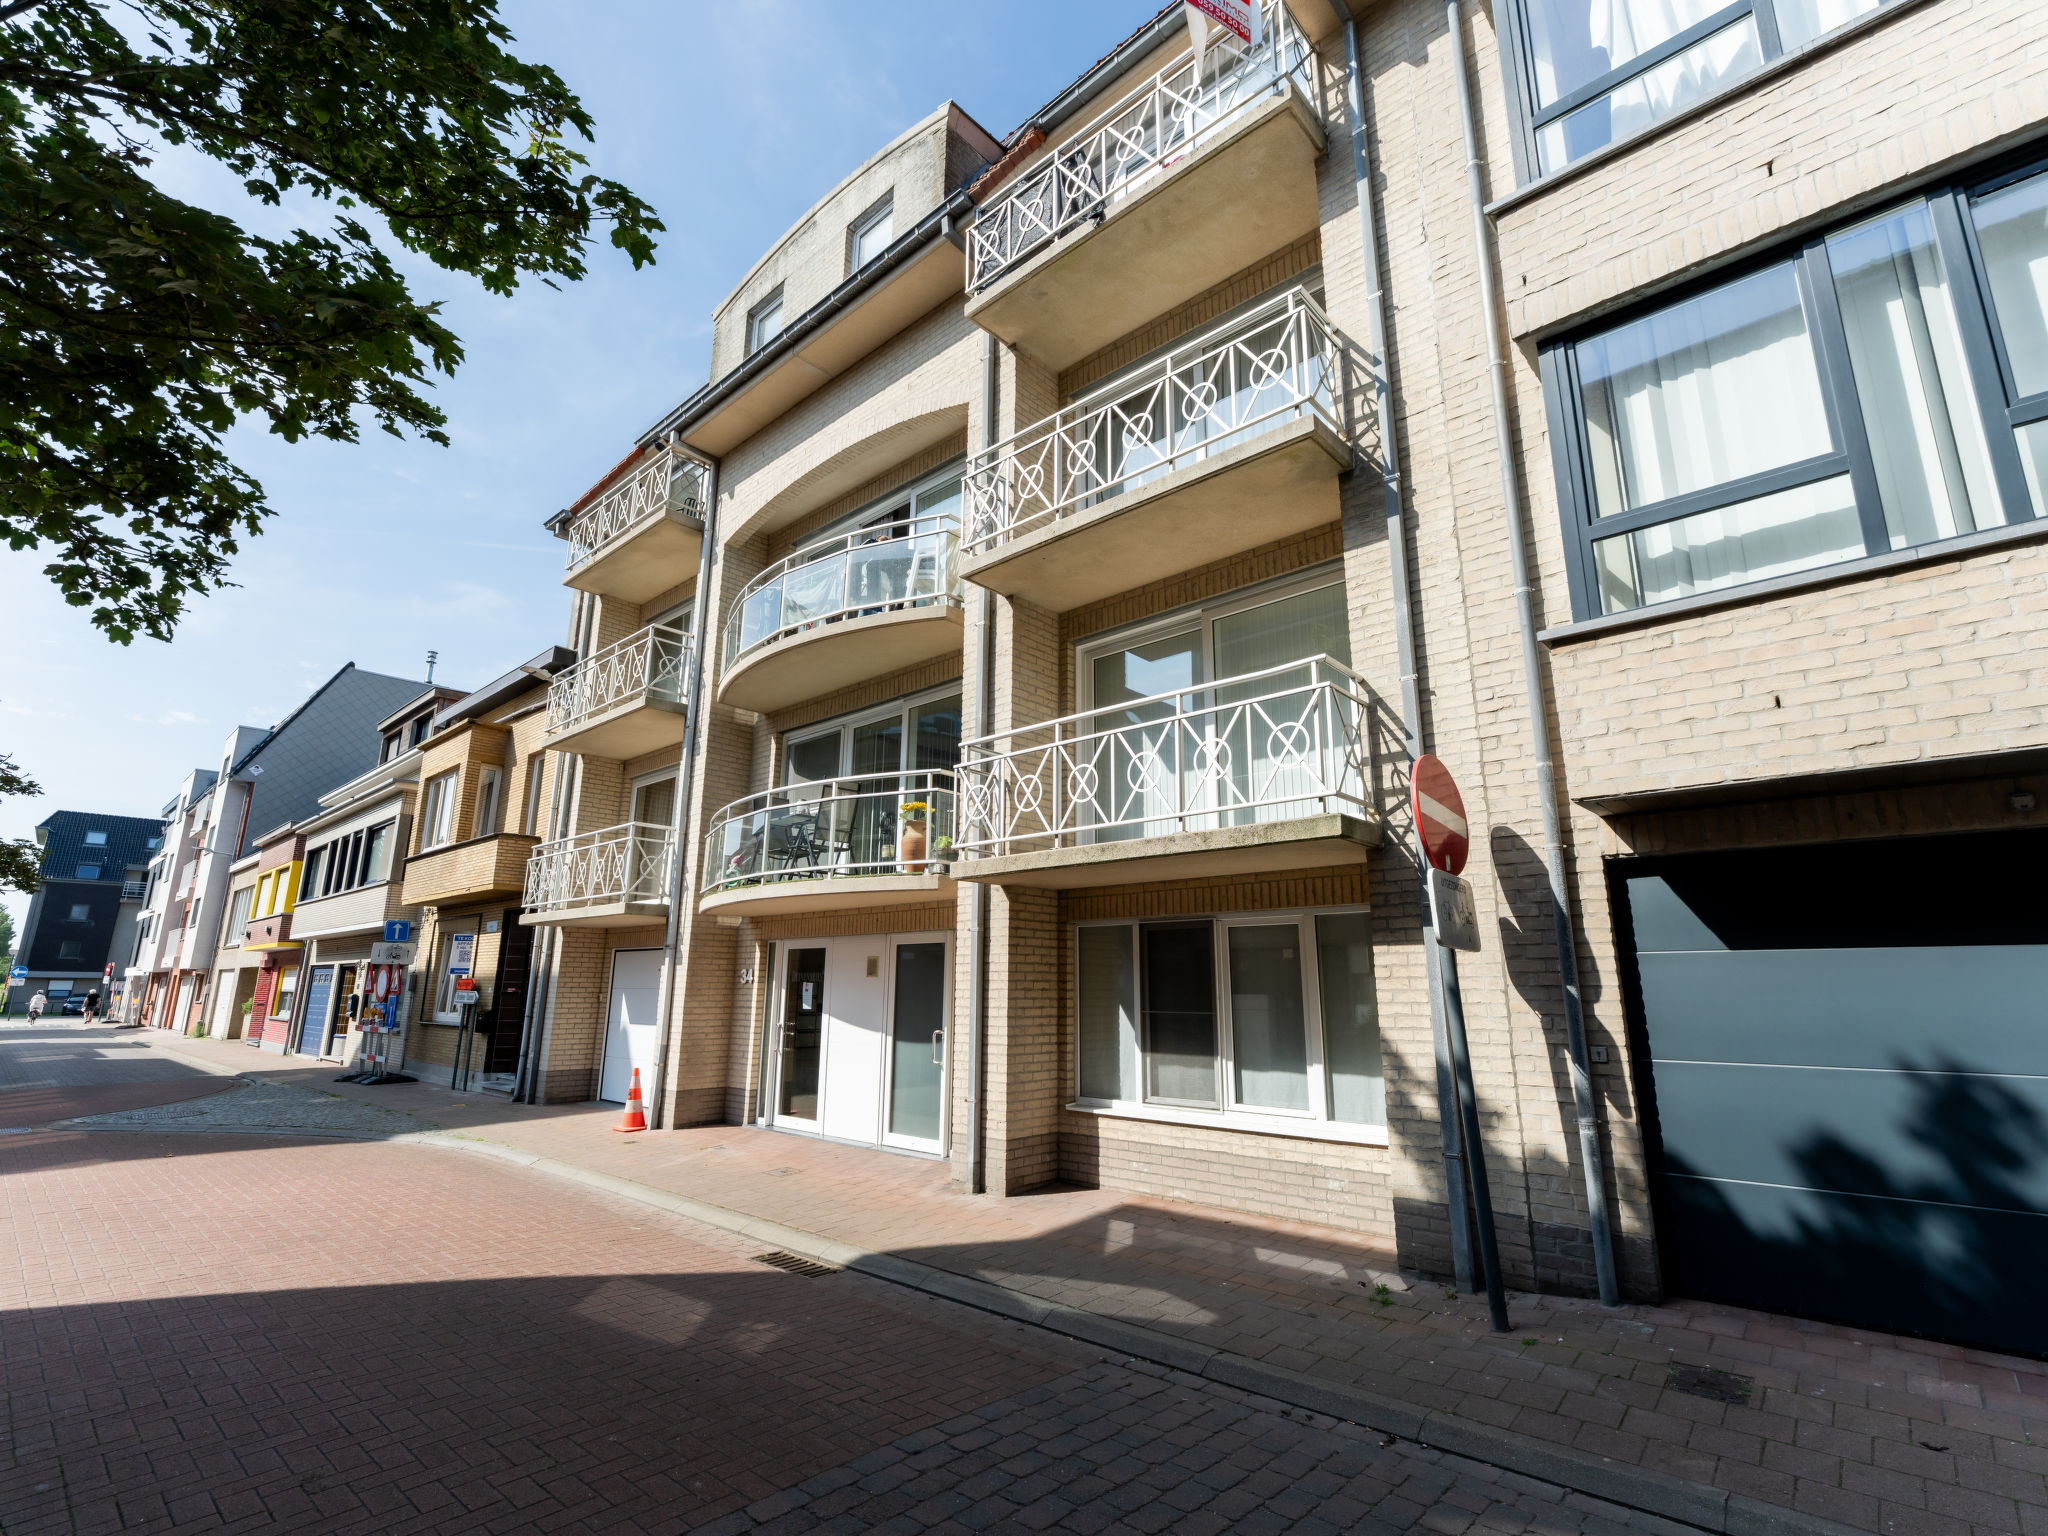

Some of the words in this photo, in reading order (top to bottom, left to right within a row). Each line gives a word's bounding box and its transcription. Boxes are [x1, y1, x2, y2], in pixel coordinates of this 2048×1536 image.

[1216, 9, 1226, 20] 50
[1228, 16, 1238, 27] 50
[1239, 24, 1250, 36] 00
[740, 968, 754, 984] 34
